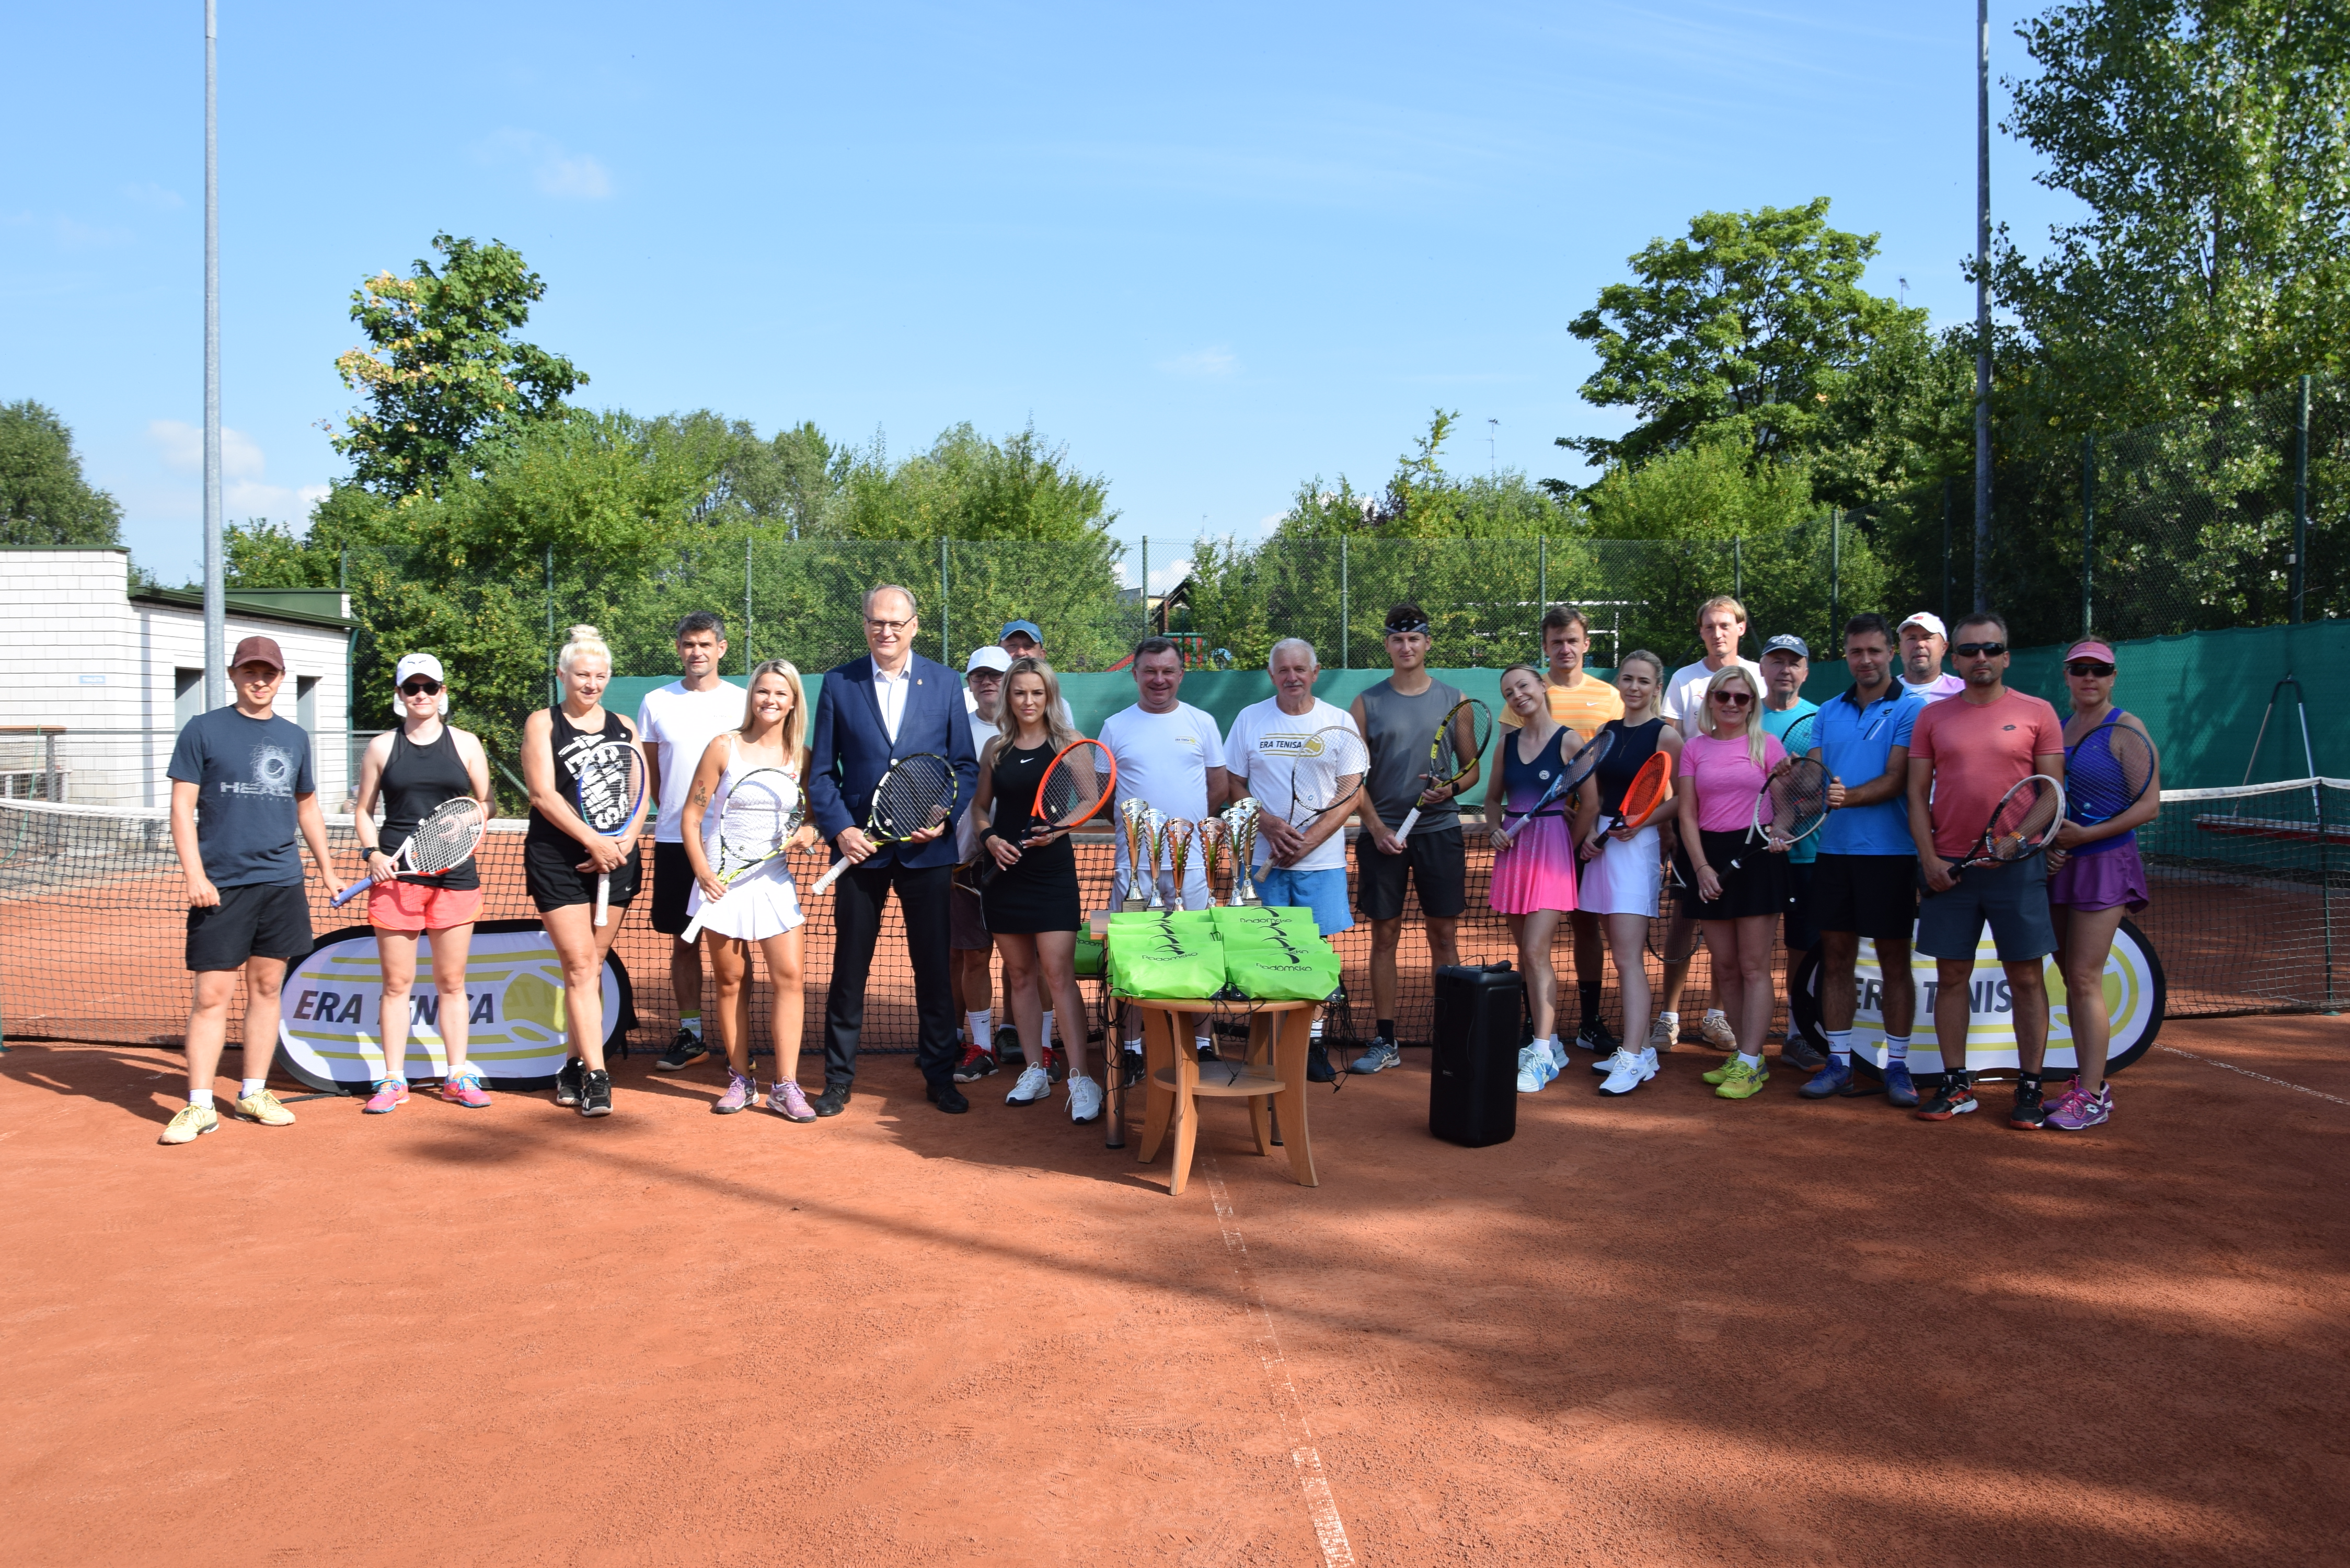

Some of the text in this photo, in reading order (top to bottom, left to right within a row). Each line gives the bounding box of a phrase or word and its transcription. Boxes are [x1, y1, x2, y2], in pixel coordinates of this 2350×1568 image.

[1076, 937, 1103, 947] Radom
[1256, 963, 1312, 972] Radomsko
[1856, 977, 2012, 1013] ER TNIS
[293, 990, 363, 1024] ERA
